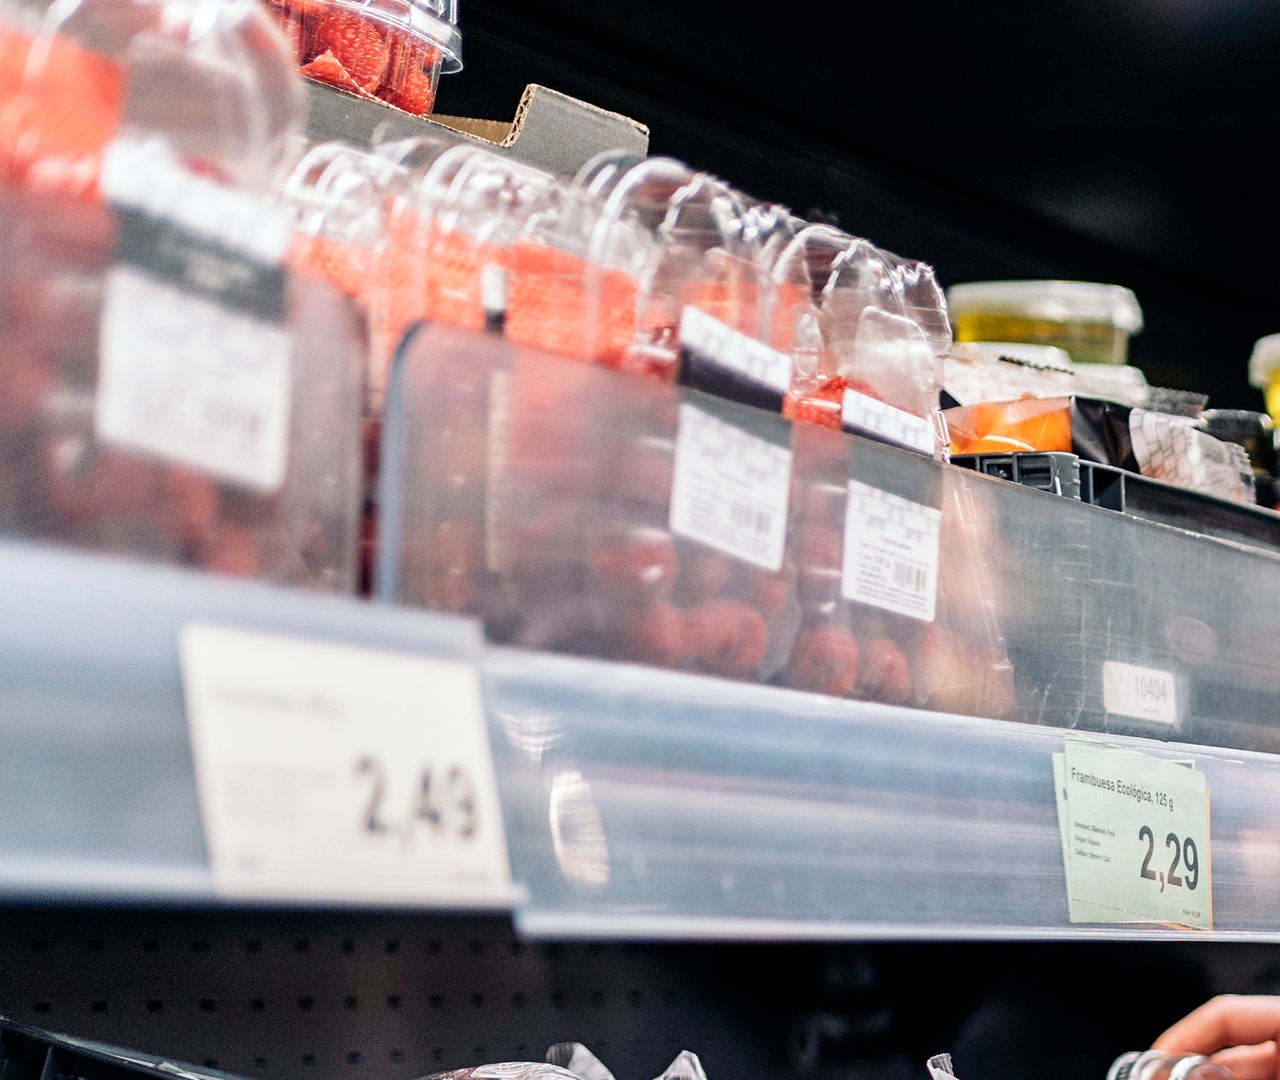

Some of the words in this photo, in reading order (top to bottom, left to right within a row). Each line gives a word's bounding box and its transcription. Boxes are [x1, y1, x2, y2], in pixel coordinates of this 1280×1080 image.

[352, 753, 477, 852] 2,49
[1071, 767, 1115, 791] Frambuesa
[1117, 780, 1154, 805] Ecológica,
[1155, 792, 1168, 807] 125
[1168, 798, 1174, 812] g
[1139, 825, 1199, 893] 2,29
